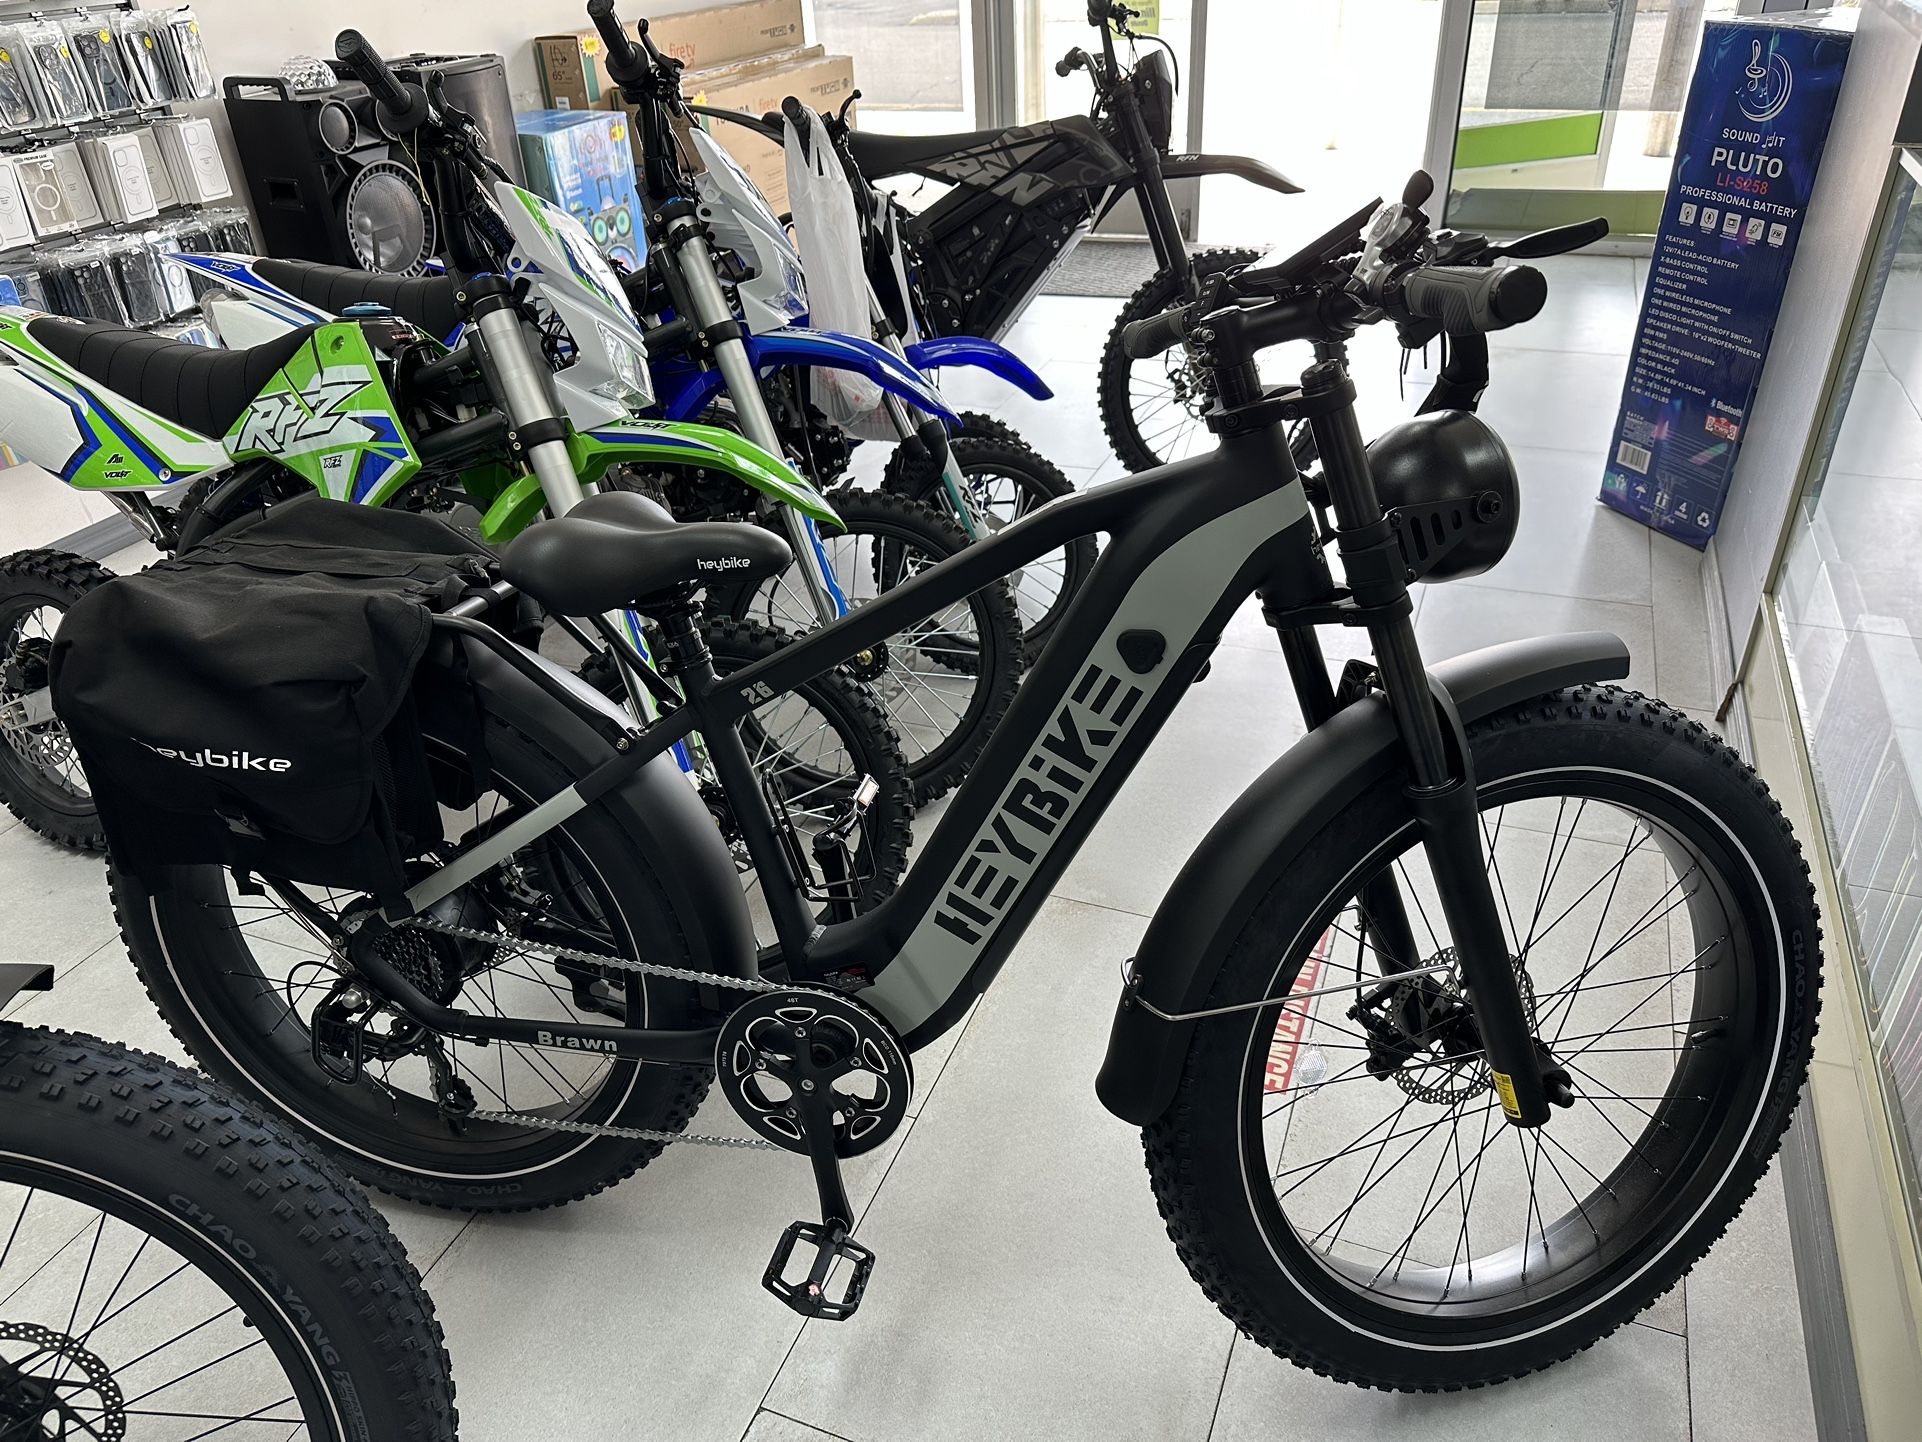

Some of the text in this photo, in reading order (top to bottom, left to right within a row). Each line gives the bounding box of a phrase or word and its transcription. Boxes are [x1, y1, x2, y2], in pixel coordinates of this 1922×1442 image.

[1722, 127, 1760, 144] SOUND
[1176, 154, 1200, 162] RFN
[1711, 146, 1783, 179] PLUTO
[1716, 172, 1769, 196] LI-S258
[1680, 184, 1798, 219] PROFESSIONAL BATTERY
[1665, 235, 1696, 247] FEATURES:
[1660, 256, 1709, 273] X-BASS CONTROL
[1681, 250, 1712, 262] LEAD-ACID
[1712, 258, 1739, 269] BATTERY
[1655, 277, 1686, 290] EQUALIZER
[1658, 267, 1708, 284] REMOTE CONTROL
[1651, 297, 1718, 322] ONE WIRED MICROPHONE
[1653, 287, 1731, 314] ONE WIRELESS MICROPHONE
[1646, 318, 1671, 329] SPEAKER
[1659, 311, 1676, 320] DISCO
[1677, 316, 1693, 325] LIGHT
[1694, 321, 1708, 330] WITH
[1730, 332, 1752, 344] SWITCH
[1692, 386, 1705, 395] INCH
[234, 380, 373, 454] RFZ
[1715, 400, 1743, 417] Bluetooth
[323, 455, 343, 468] RFZ
[1678, 500, 1687, 513] 4
[697, 557, 751, 571] heybike
[740, 680, 775, 705] 26
[151, 748, 292, 772] eybike
[537, 1030, 618, 1052] Brawn
[168, 1194, 341, 1366] CHAO YANG
